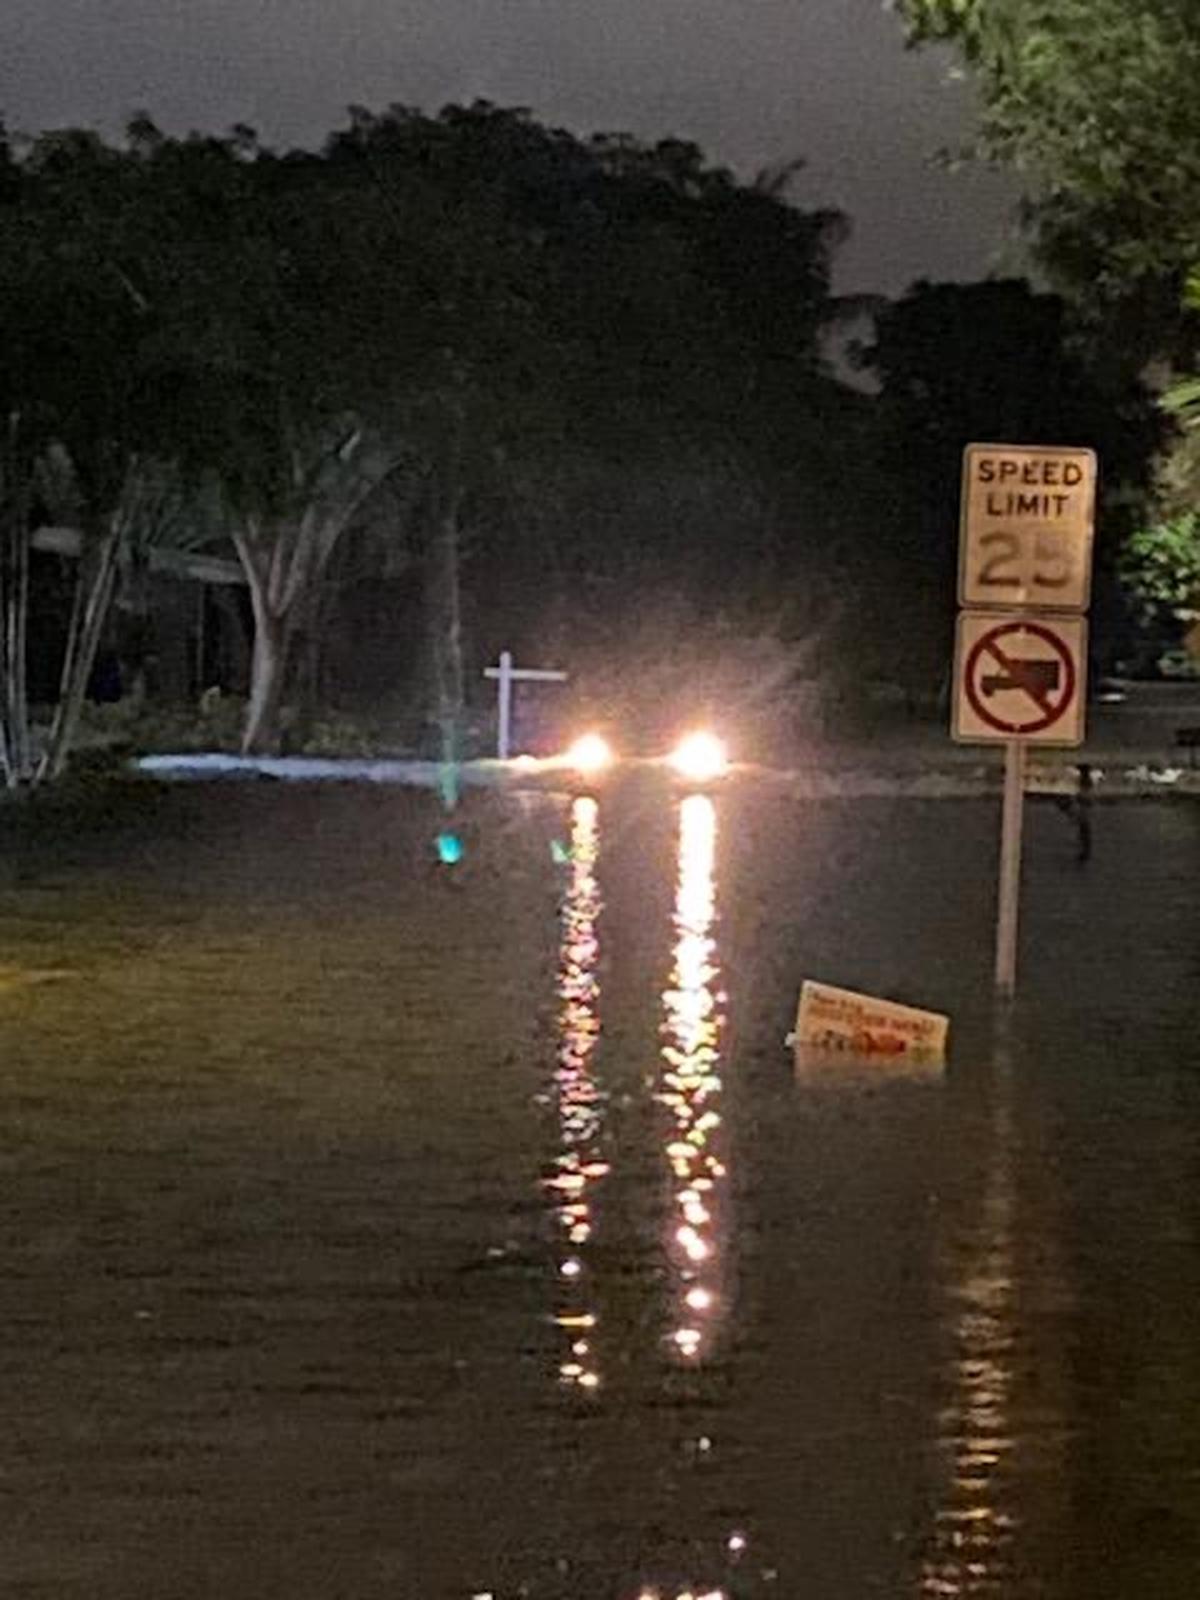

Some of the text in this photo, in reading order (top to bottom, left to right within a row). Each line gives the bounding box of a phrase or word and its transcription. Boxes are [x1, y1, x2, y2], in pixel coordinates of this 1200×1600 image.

[979, 460, 1082, 485] SPEED
[987, 493, 1069, 516] LIMIT
[978, 531, 1074, 588] 25
